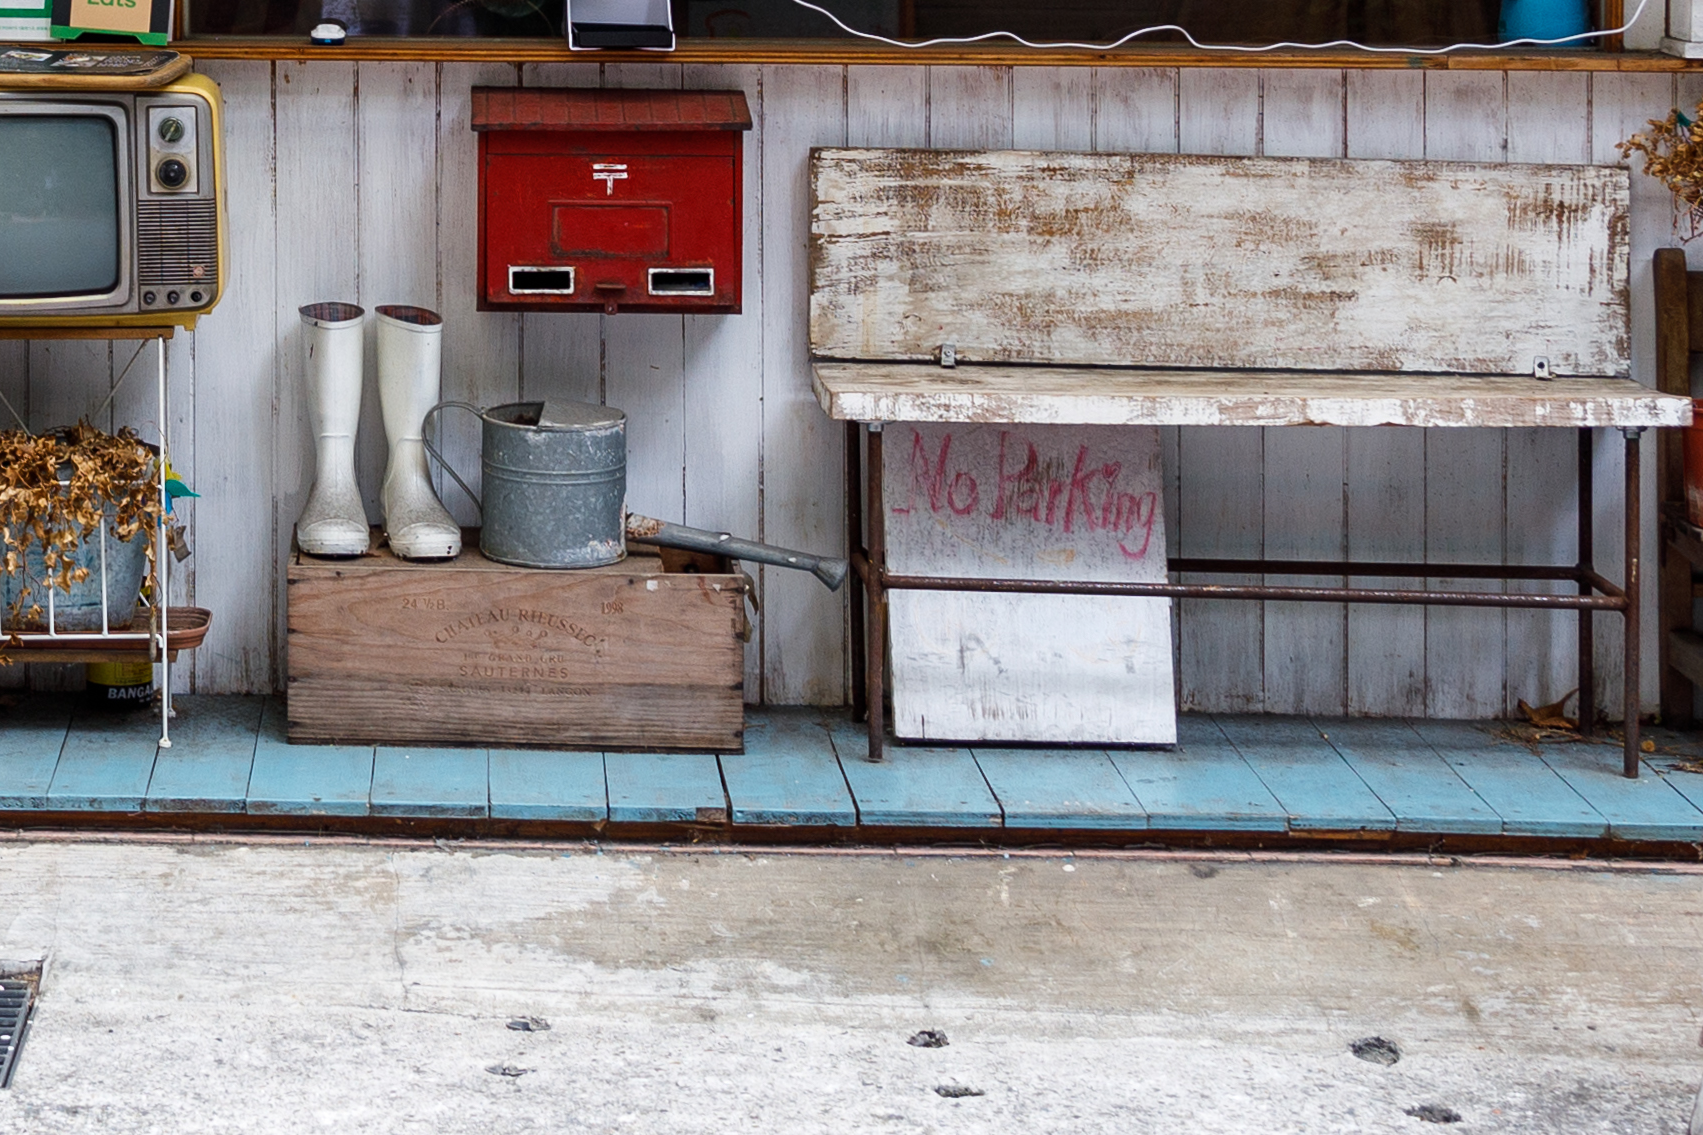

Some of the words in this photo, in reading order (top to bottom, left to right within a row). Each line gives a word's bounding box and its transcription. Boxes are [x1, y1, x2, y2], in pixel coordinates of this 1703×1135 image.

[892, 426, 979, 516] No
[600, 601, 625, 616] 1998
[435, 607, 510, 644] CHATEAU
[518, 608, 597, 647] RIEUSSEC
[459, 665, 570, 680] SAUTERNES
